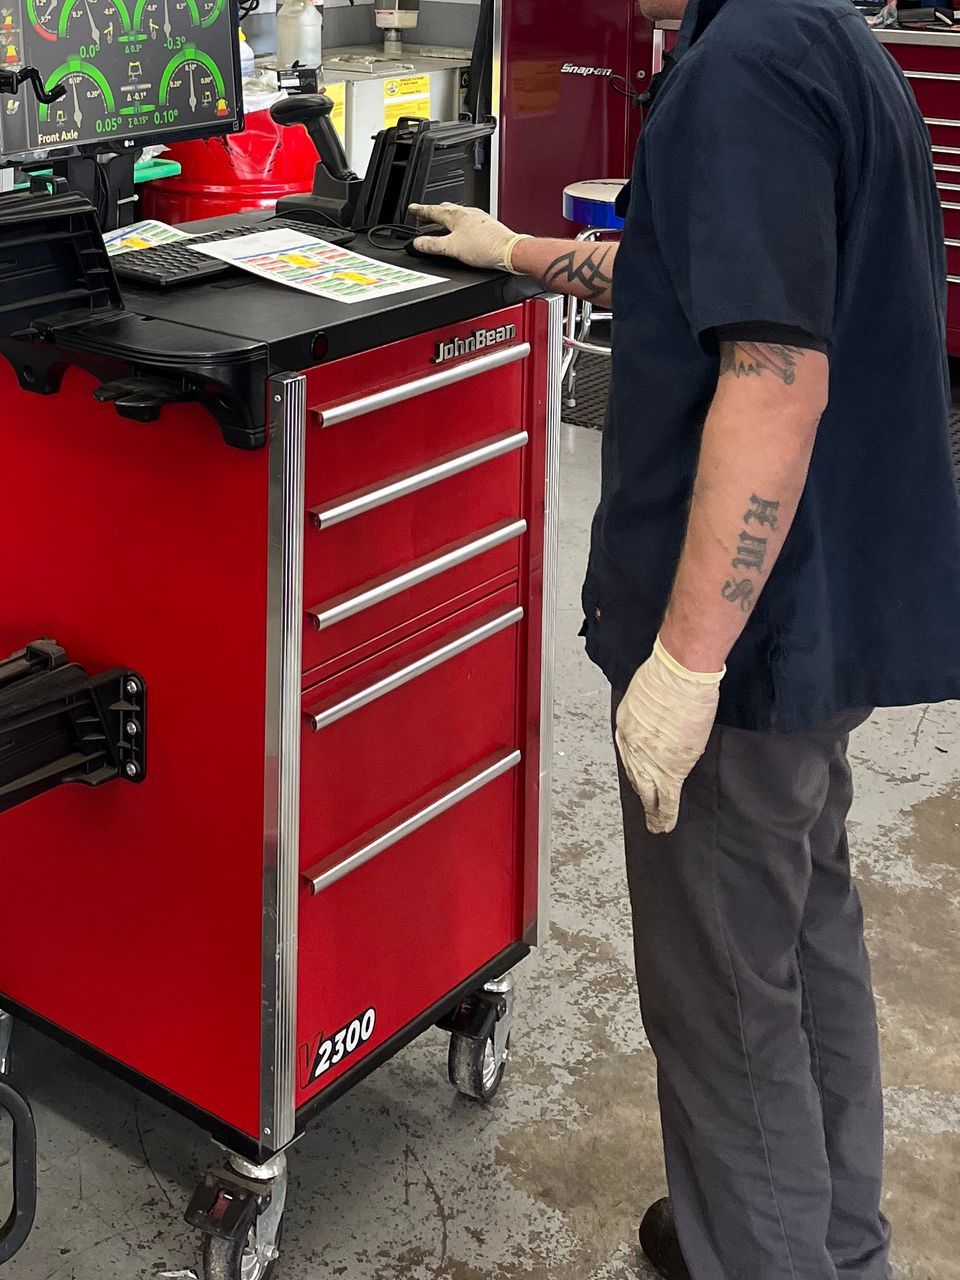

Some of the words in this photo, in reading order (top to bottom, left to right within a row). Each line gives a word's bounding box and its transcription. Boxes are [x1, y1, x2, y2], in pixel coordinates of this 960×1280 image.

[560, 62, 612, 76] Snap-on
[154, 109, 179, 124] 0.10°
[95, 117, 122, 133] 0.05°
[38, 132, 60, 145] Front
[61, 130, 79, 141] Axle
[434, 323, 516, 363] JohnBean
